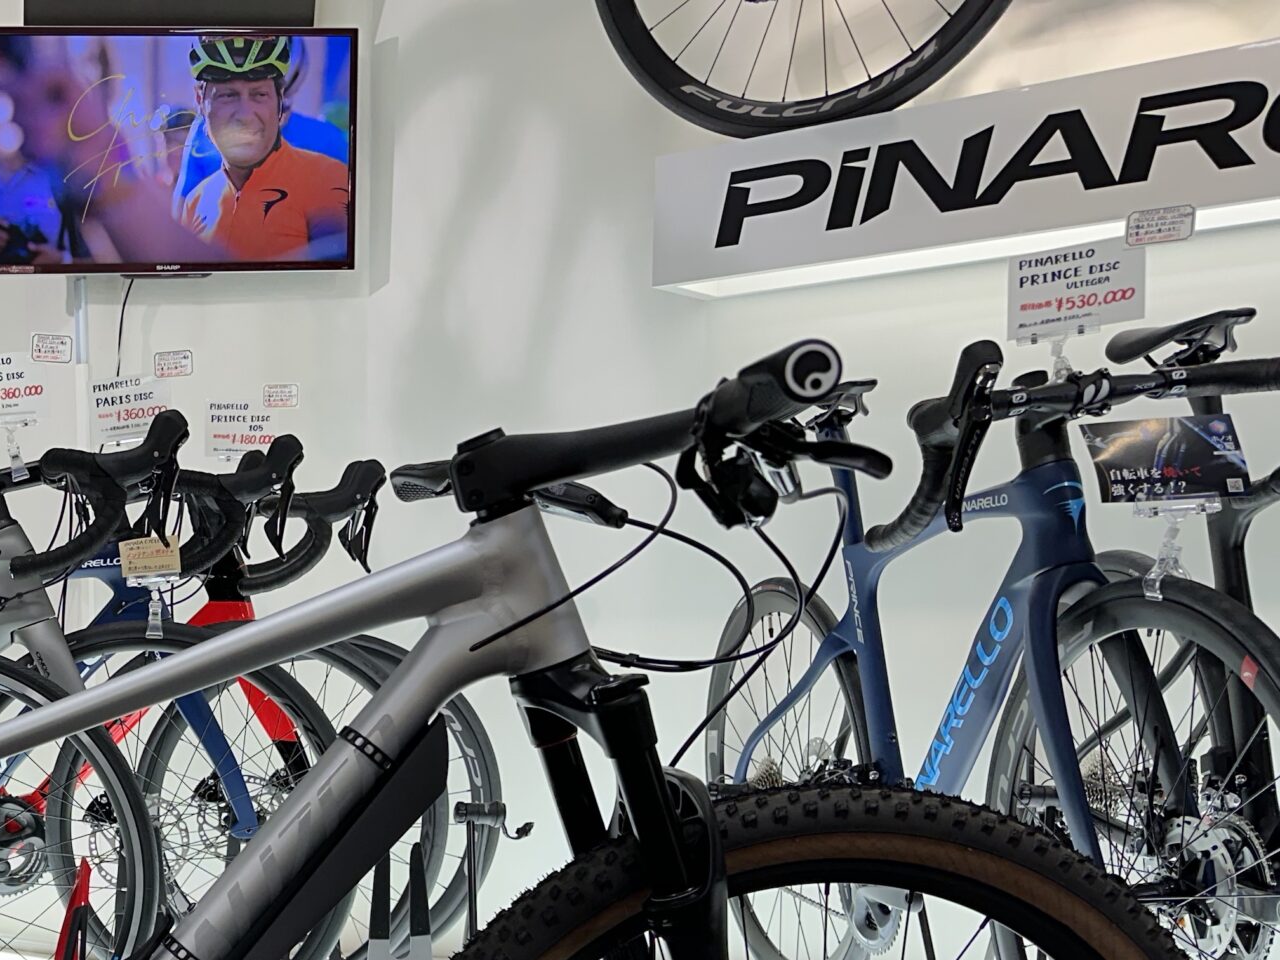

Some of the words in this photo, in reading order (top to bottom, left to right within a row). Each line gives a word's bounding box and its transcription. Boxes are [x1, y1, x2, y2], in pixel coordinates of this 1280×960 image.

[680, 38, 938, 118] FULCRUM
[1019, 249, 1095, 270] PINARELLO
[1019, 266, 1082, 288] PRINCE
[1089, 261, 1120, 275] DISC
[1066, 276, 1110, 289] ULTEGRA
[6, 371, 25, 381] DISC
[93, 379, 141, 393] PINARELLO
[96, 394, 131, 408] PARIS
[134, 392, 154, 402] DISC
[210, 403, 249, 411] PINARELLO
[1109, 465, 1203, 481] 自転車を焼いて
[845, 559, 865, 645] PRINCE
